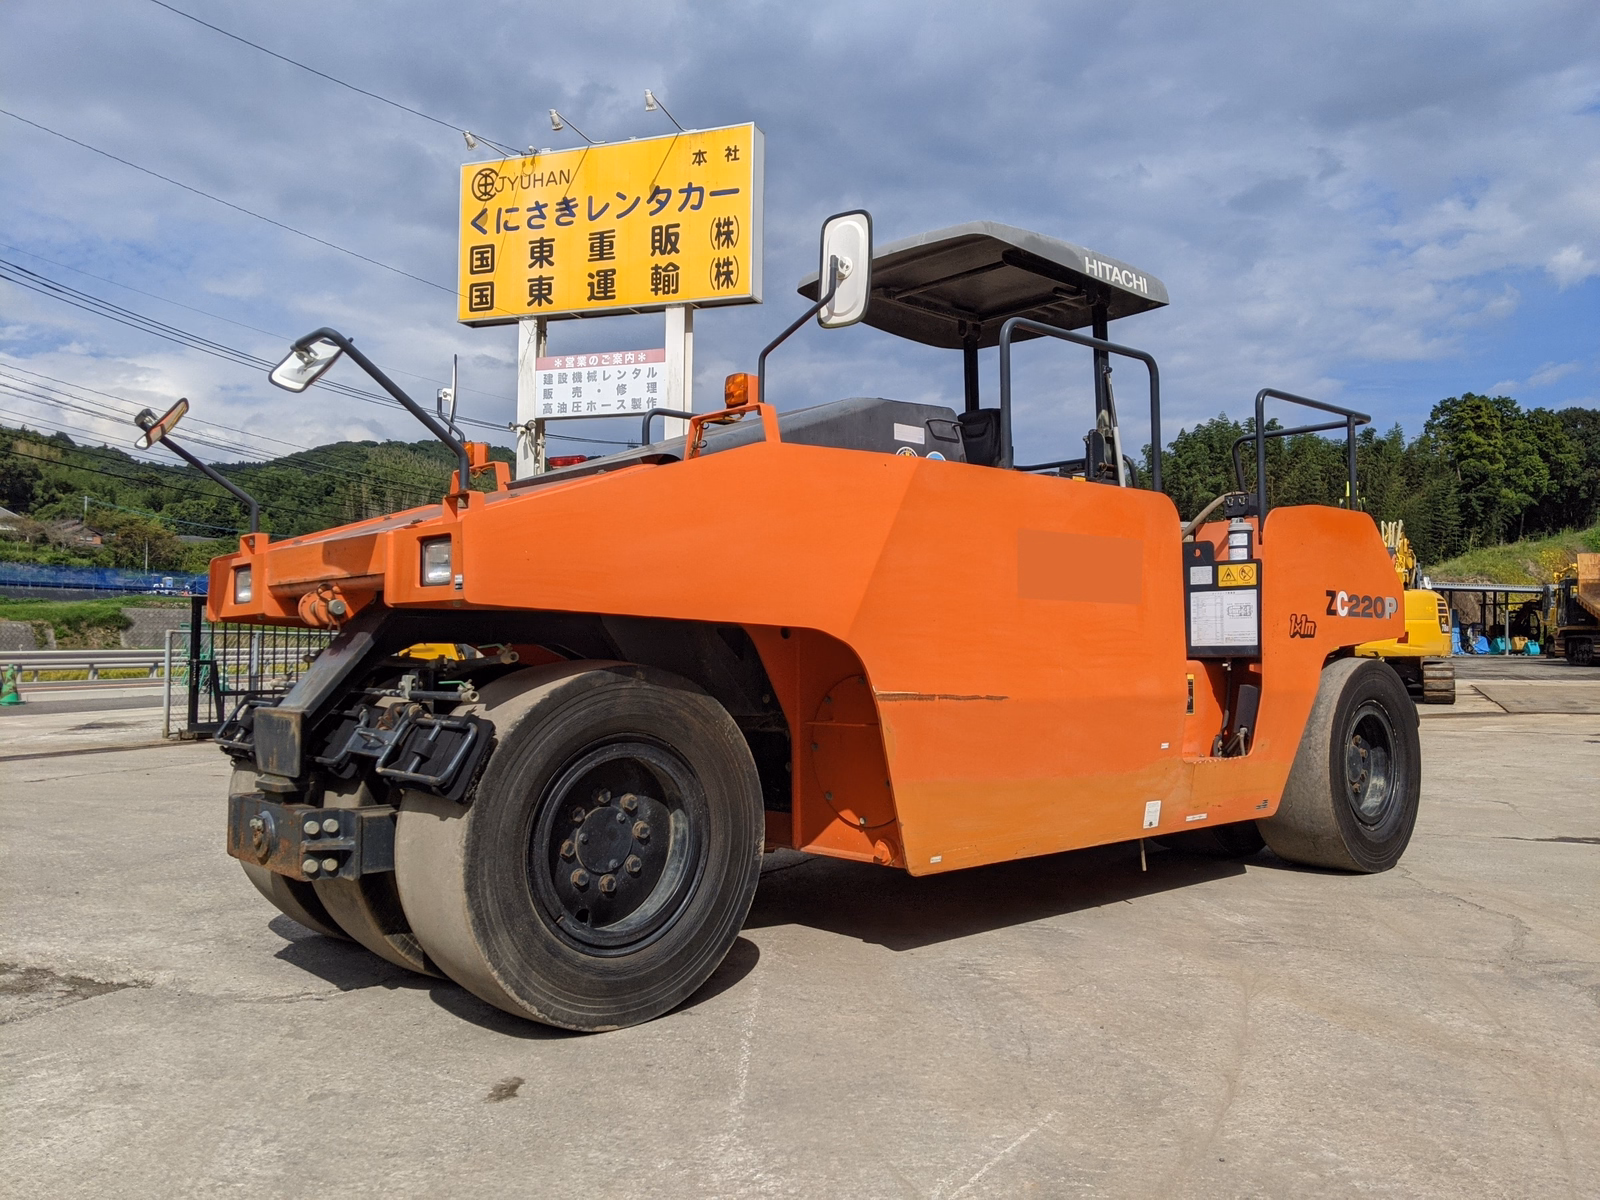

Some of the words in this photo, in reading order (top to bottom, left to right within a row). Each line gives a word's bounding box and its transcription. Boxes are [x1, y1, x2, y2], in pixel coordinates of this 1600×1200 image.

[691, 144, 741, 166] 本社
[494, 168, 571, 193] JYUHAN
[470, 181, 740, 235] くにさきレンタカー
[1084, 256, 1148, 294] HITACHI
[543, 366, 658, 385] 建設機械レンタル
[542, 397, 657, 415] 高油圧ホース製作
[1325, 589, 1399, 619] ZC220P
